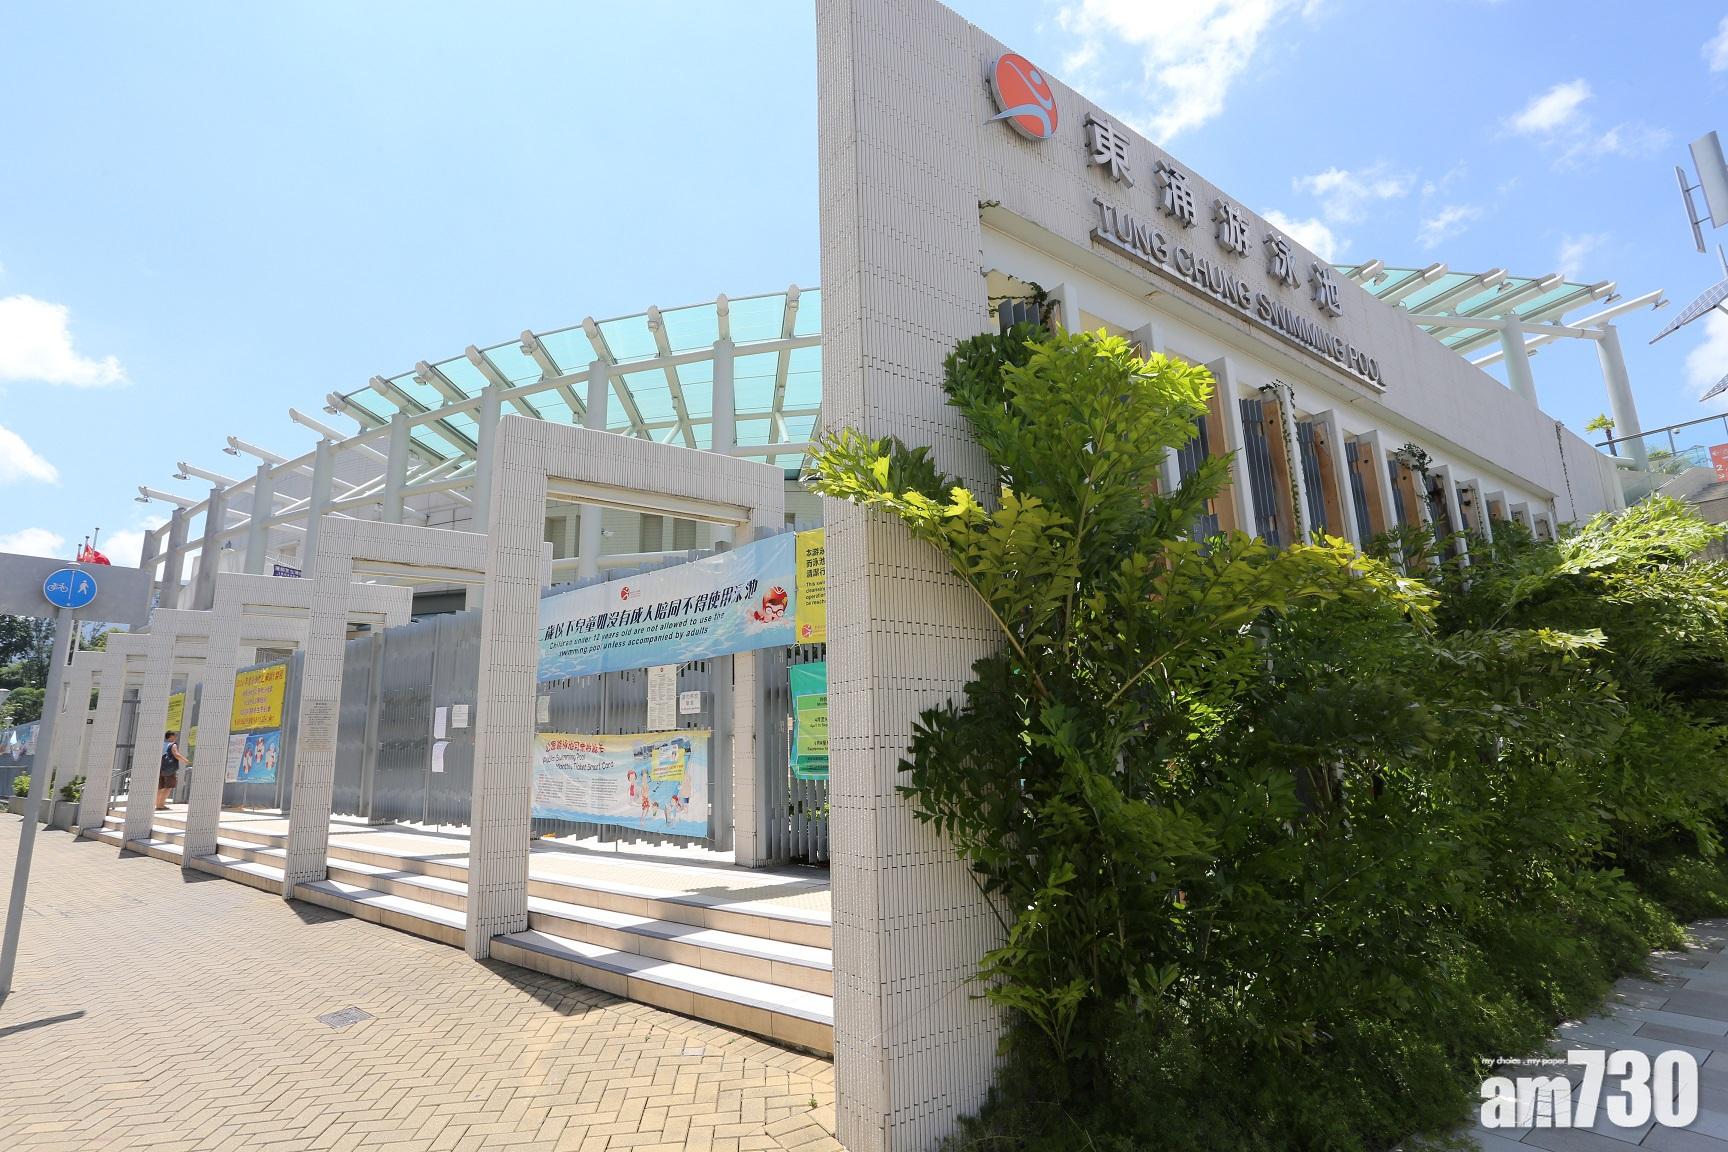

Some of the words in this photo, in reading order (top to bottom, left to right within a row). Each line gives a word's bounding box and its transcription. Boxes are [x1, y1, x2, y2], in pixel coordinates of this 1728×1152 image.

[1092, 197, 1168, 264] TUNG
[1175, 246, 1252, 310] CHUNG
[1255, 292, 1345, 362] SWIMMING
[1345, 343, 1387, 387] POOL
[573, 637, 591, 645] under
[593, 634, 600, 642] 12
[601, 631, 619, 642] years
[621, 628, 631, 637] old
[633, 627, 645, 636] are
[646, 624, 658, 633] not
[659, 618, 687, 631] allowed
[689, 617, 697, 626] to
[699, 615, 712, 624] use
[714, 612, 725, 621] the
[603, 639, 626, 650] unless
[627, 632, 673, 646] accompanied
[675, 630, 683, 640] by
[685, 627, 709, 637] adults
